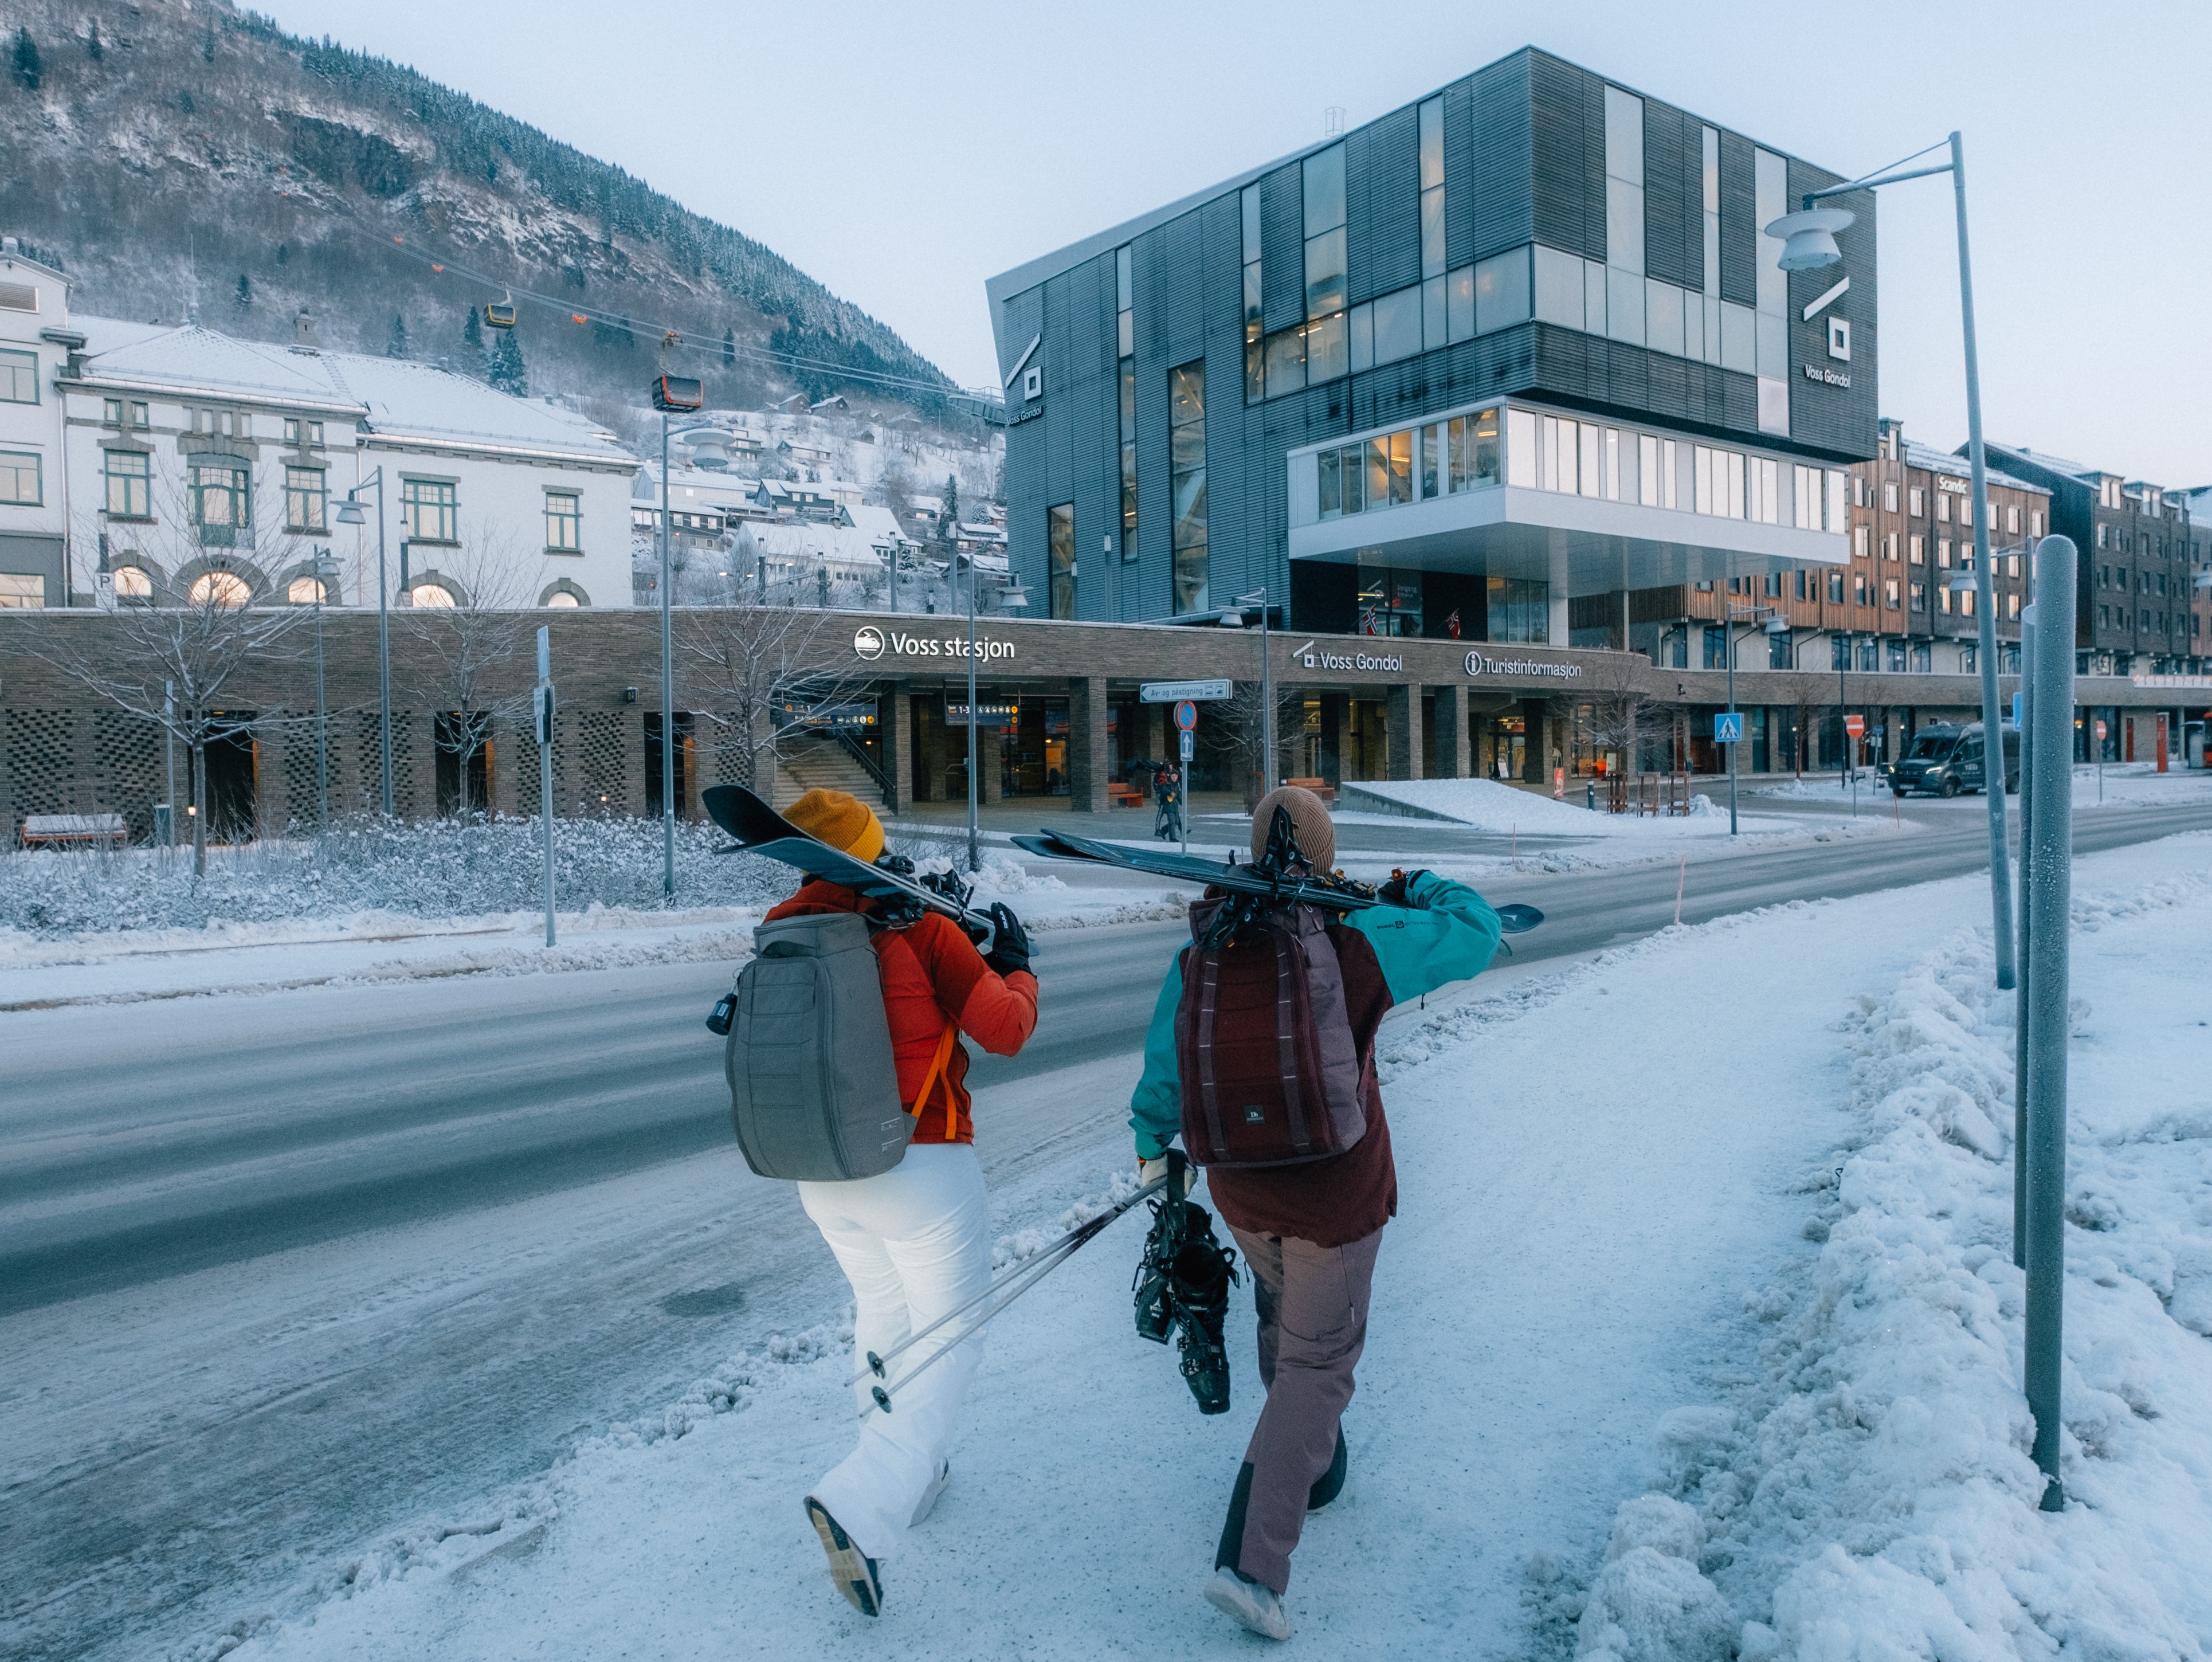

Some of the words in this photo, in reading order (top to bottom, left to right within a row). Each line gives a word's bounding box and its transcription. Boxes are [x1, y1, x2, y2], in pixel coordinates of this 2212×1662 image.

[1805, 364, 1823, 381] Voss
[1824, 369, 1850, 388] Gondol
[1006, 415, 1019, 426] Voss
[1021, 405, 1042, 421] Gondol
[1939, 476, 1967, 494] Scandic
[100, 575, 111, 588] P
[891, 632, 939, 656] Voss
[944, 636, 1015, 663] stasjon
[1320, 652, 1352, 669] Voss
[1356, 653, 1402, 671] Gondol
[1484, 658, 1582, 680] Turistinformasjon
[1162, 689, 1170, 697] og
[1171, 687, 1203, 696] påstigning
